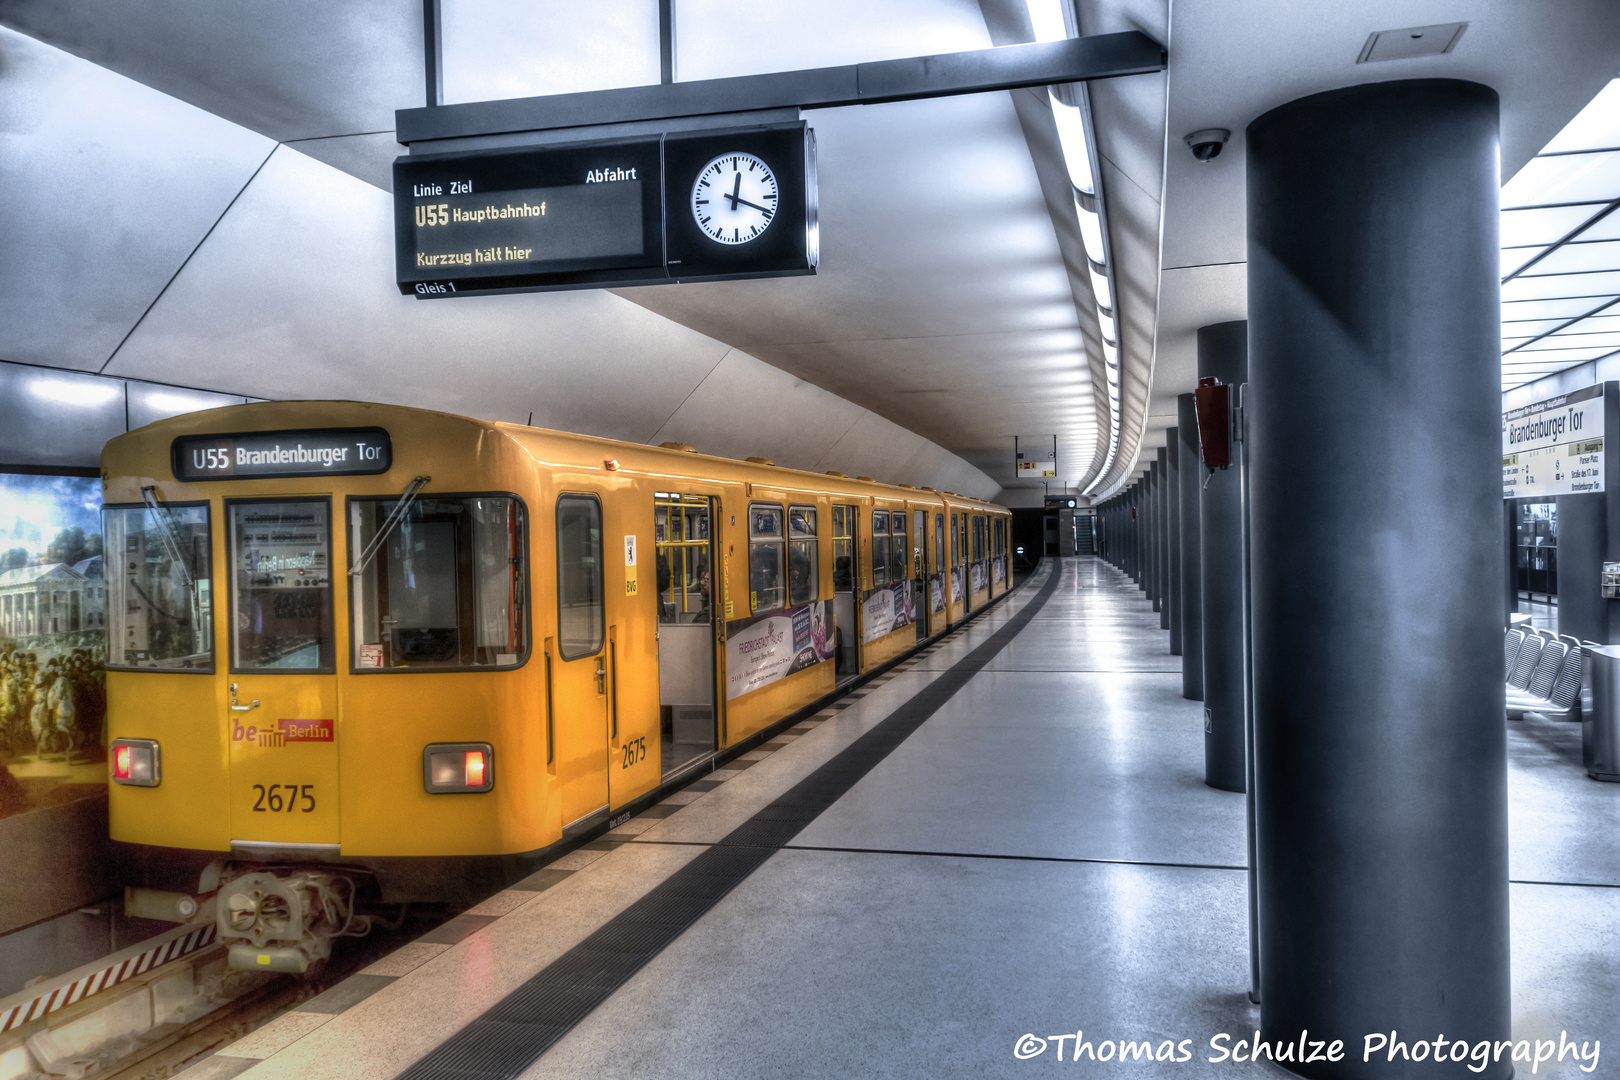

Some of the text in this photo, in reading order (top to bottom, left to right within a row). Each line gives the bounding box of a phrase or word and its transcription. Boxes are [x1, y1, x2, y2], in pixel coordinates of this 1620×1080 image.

[413, 167, 637, 198] Linie Ziel Abfahrt
[415, 202, 547, 227] U55 Hauptbahnhof
[416, 246, 532, 268] Kurzzug hält hier
[415, 281, 456, 296] Gleis 1
[1509, 415, 1566, 445] Brandenburger
[1568, 408, 1584, 432] Tor
[193, 443, 382, 470] U55 Brandenburger Tor
[626, 580, 636, 594] BVG
[232, 718, 329, 743] be Berlin
[622, 736, 646, 769] 2675
[253, 784, 316, 813] 2675
